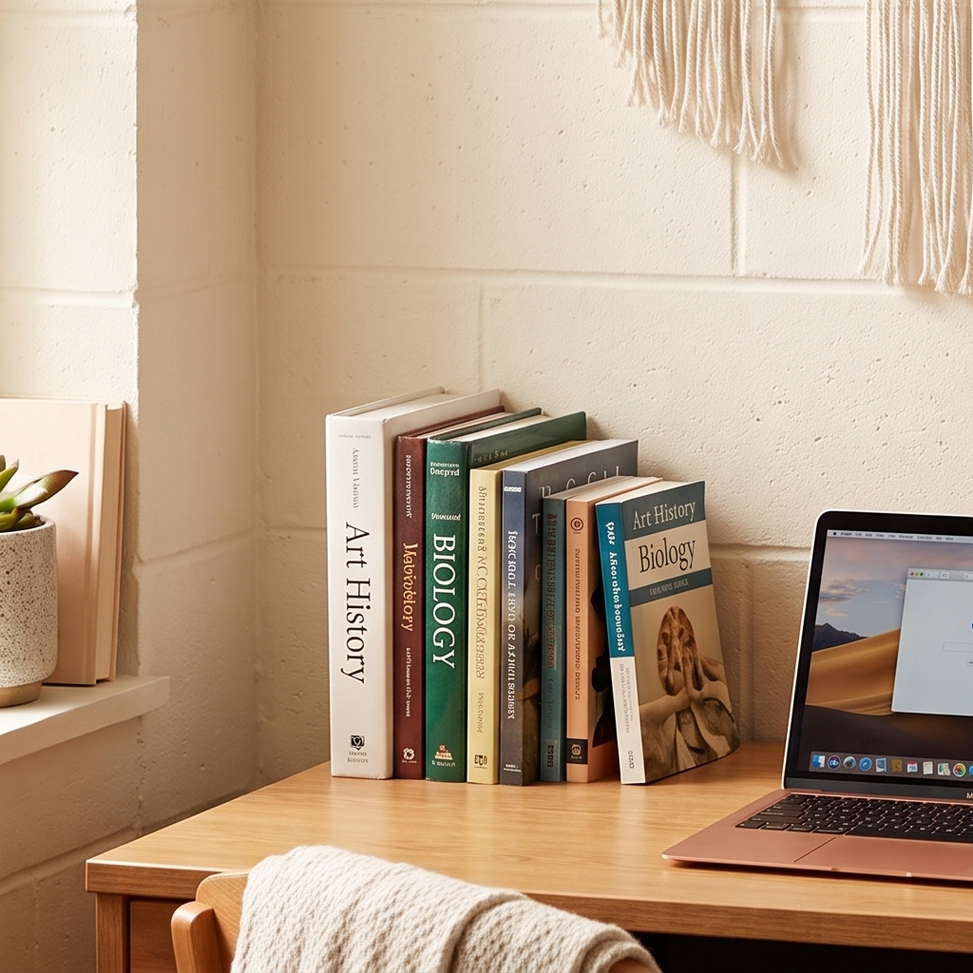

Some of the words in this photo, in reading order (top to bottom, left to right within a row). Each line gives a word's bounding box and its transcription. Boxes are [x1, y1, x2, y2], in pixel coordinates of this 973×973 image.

[633, 511, 652, 531] Art
[653, 501, 696, 525] History
[345, 522, 371, 570] Art
[638, 537, 696, 573] Biology
[432, 533, 456, 668] BIOLOGY
[341, 577, 371, 684] History
